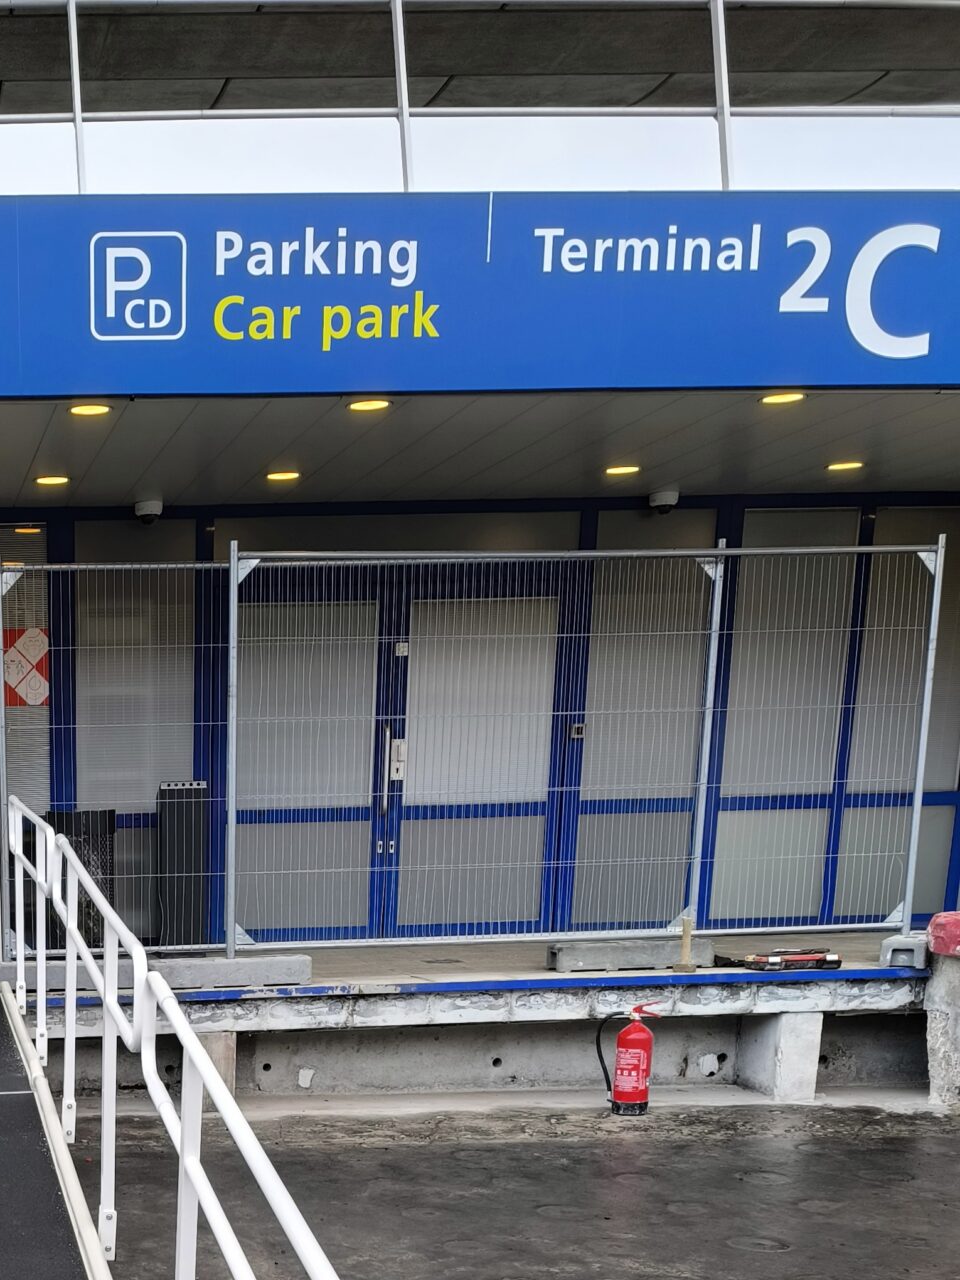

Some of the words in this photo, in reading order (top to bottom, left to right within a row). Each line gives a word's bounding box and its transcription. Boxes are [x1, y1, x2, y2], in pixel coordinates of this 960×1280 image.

[215, 227, 418, 288] Parking
[213, 295, 301, 340] Car
[322, 291, 440, 352] park
[534, 224, 762, 272] Terminal
[778, 223, 941, 359] 2C
